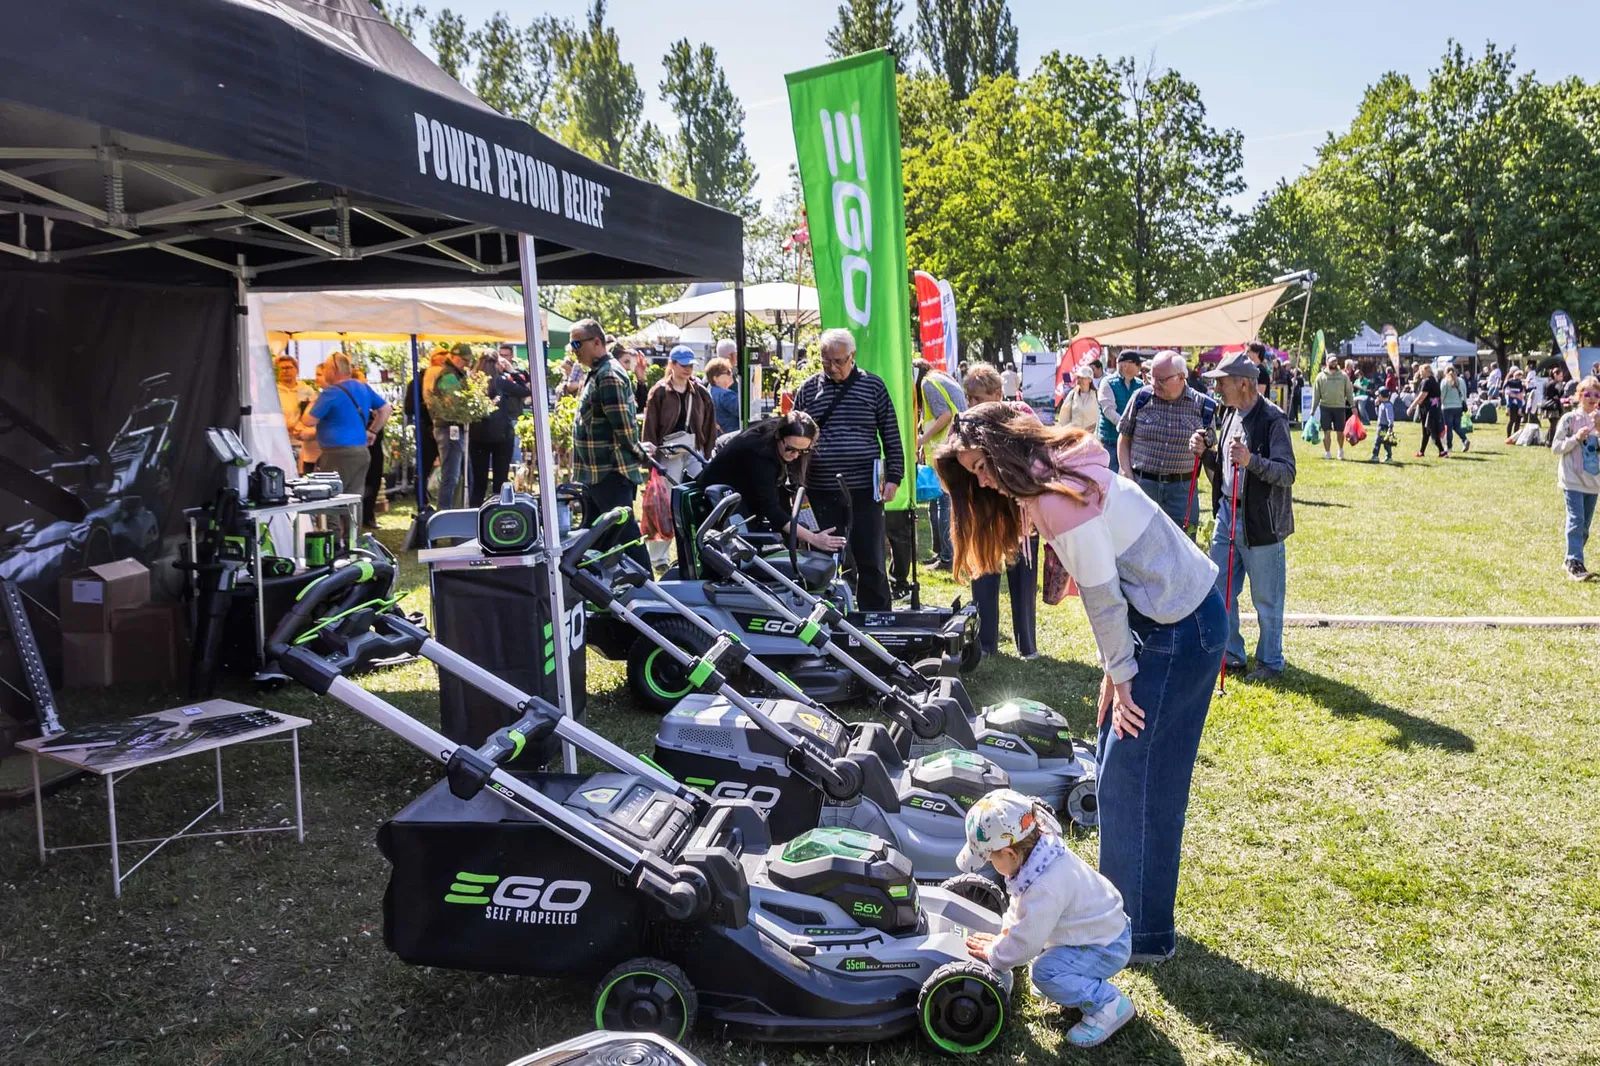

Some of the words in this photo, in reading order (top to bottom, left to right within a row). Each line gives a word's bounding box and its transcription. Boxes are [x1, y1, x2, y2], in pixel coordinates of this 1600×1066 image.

[414, 111, 494, 195] POWER
[493, 143, 560, 215] BEYOND
[819, 107, 873, 328] EGO
[747, 617, 797, 634] EGO
[985, 736, 1016, 750] EGO
[491, 782, 516, 798] EGO
[909, 796, 948, 812] EGO
[444, 871, 592, 912] EGO
[485, 906, 511, 922] SELF
[515, 909, 578, 925] PROPELLED
[853, 901, 884, 915] 56V
[846, 959, 866, 972] 55cm
[882, 962, 917, 970] PROPELLED
